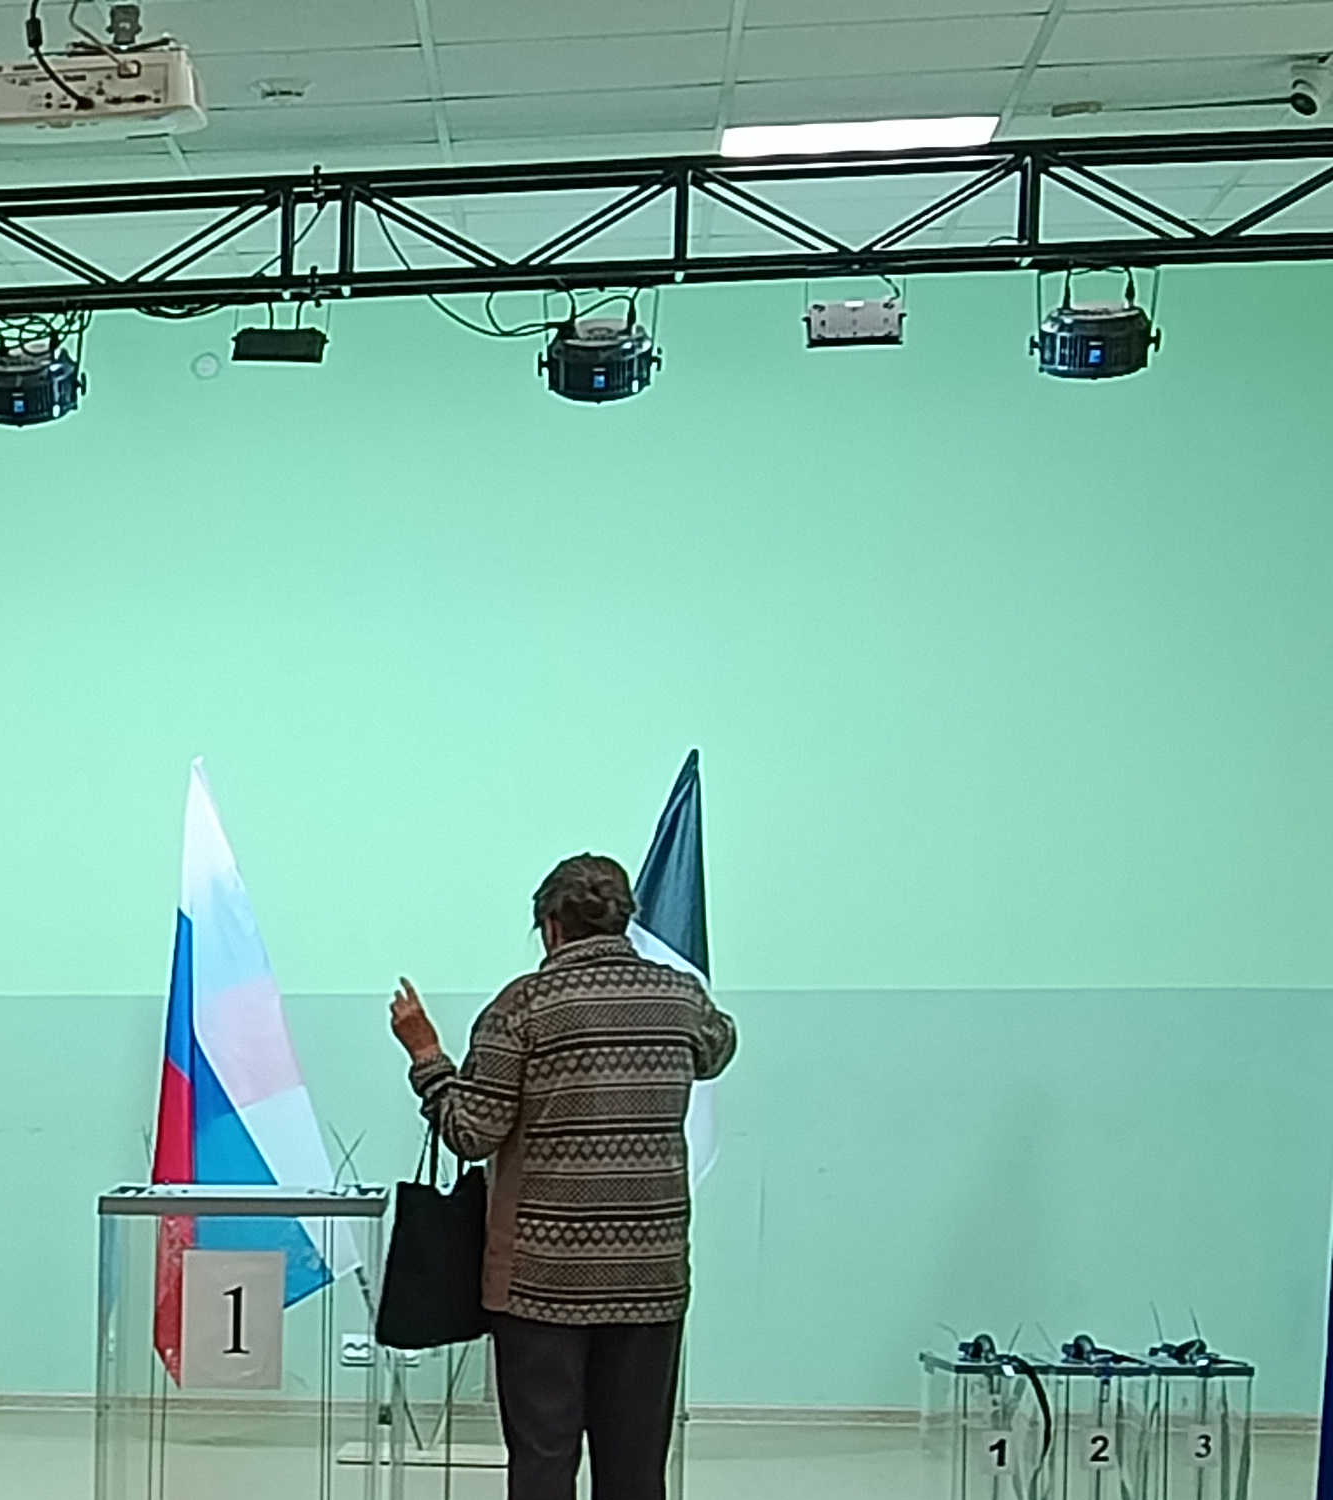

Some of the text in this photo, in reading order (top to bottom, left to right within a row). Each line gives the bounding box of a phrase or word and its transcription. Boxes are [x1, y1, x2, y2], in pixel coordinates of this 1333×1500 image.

[223, 1286, 250, 1354] 1
[989, 1438, 1007, 1467] 1
[1090, 1435, 1110, 1462] 2
[1194, 1434, 1212, 1458] 3
